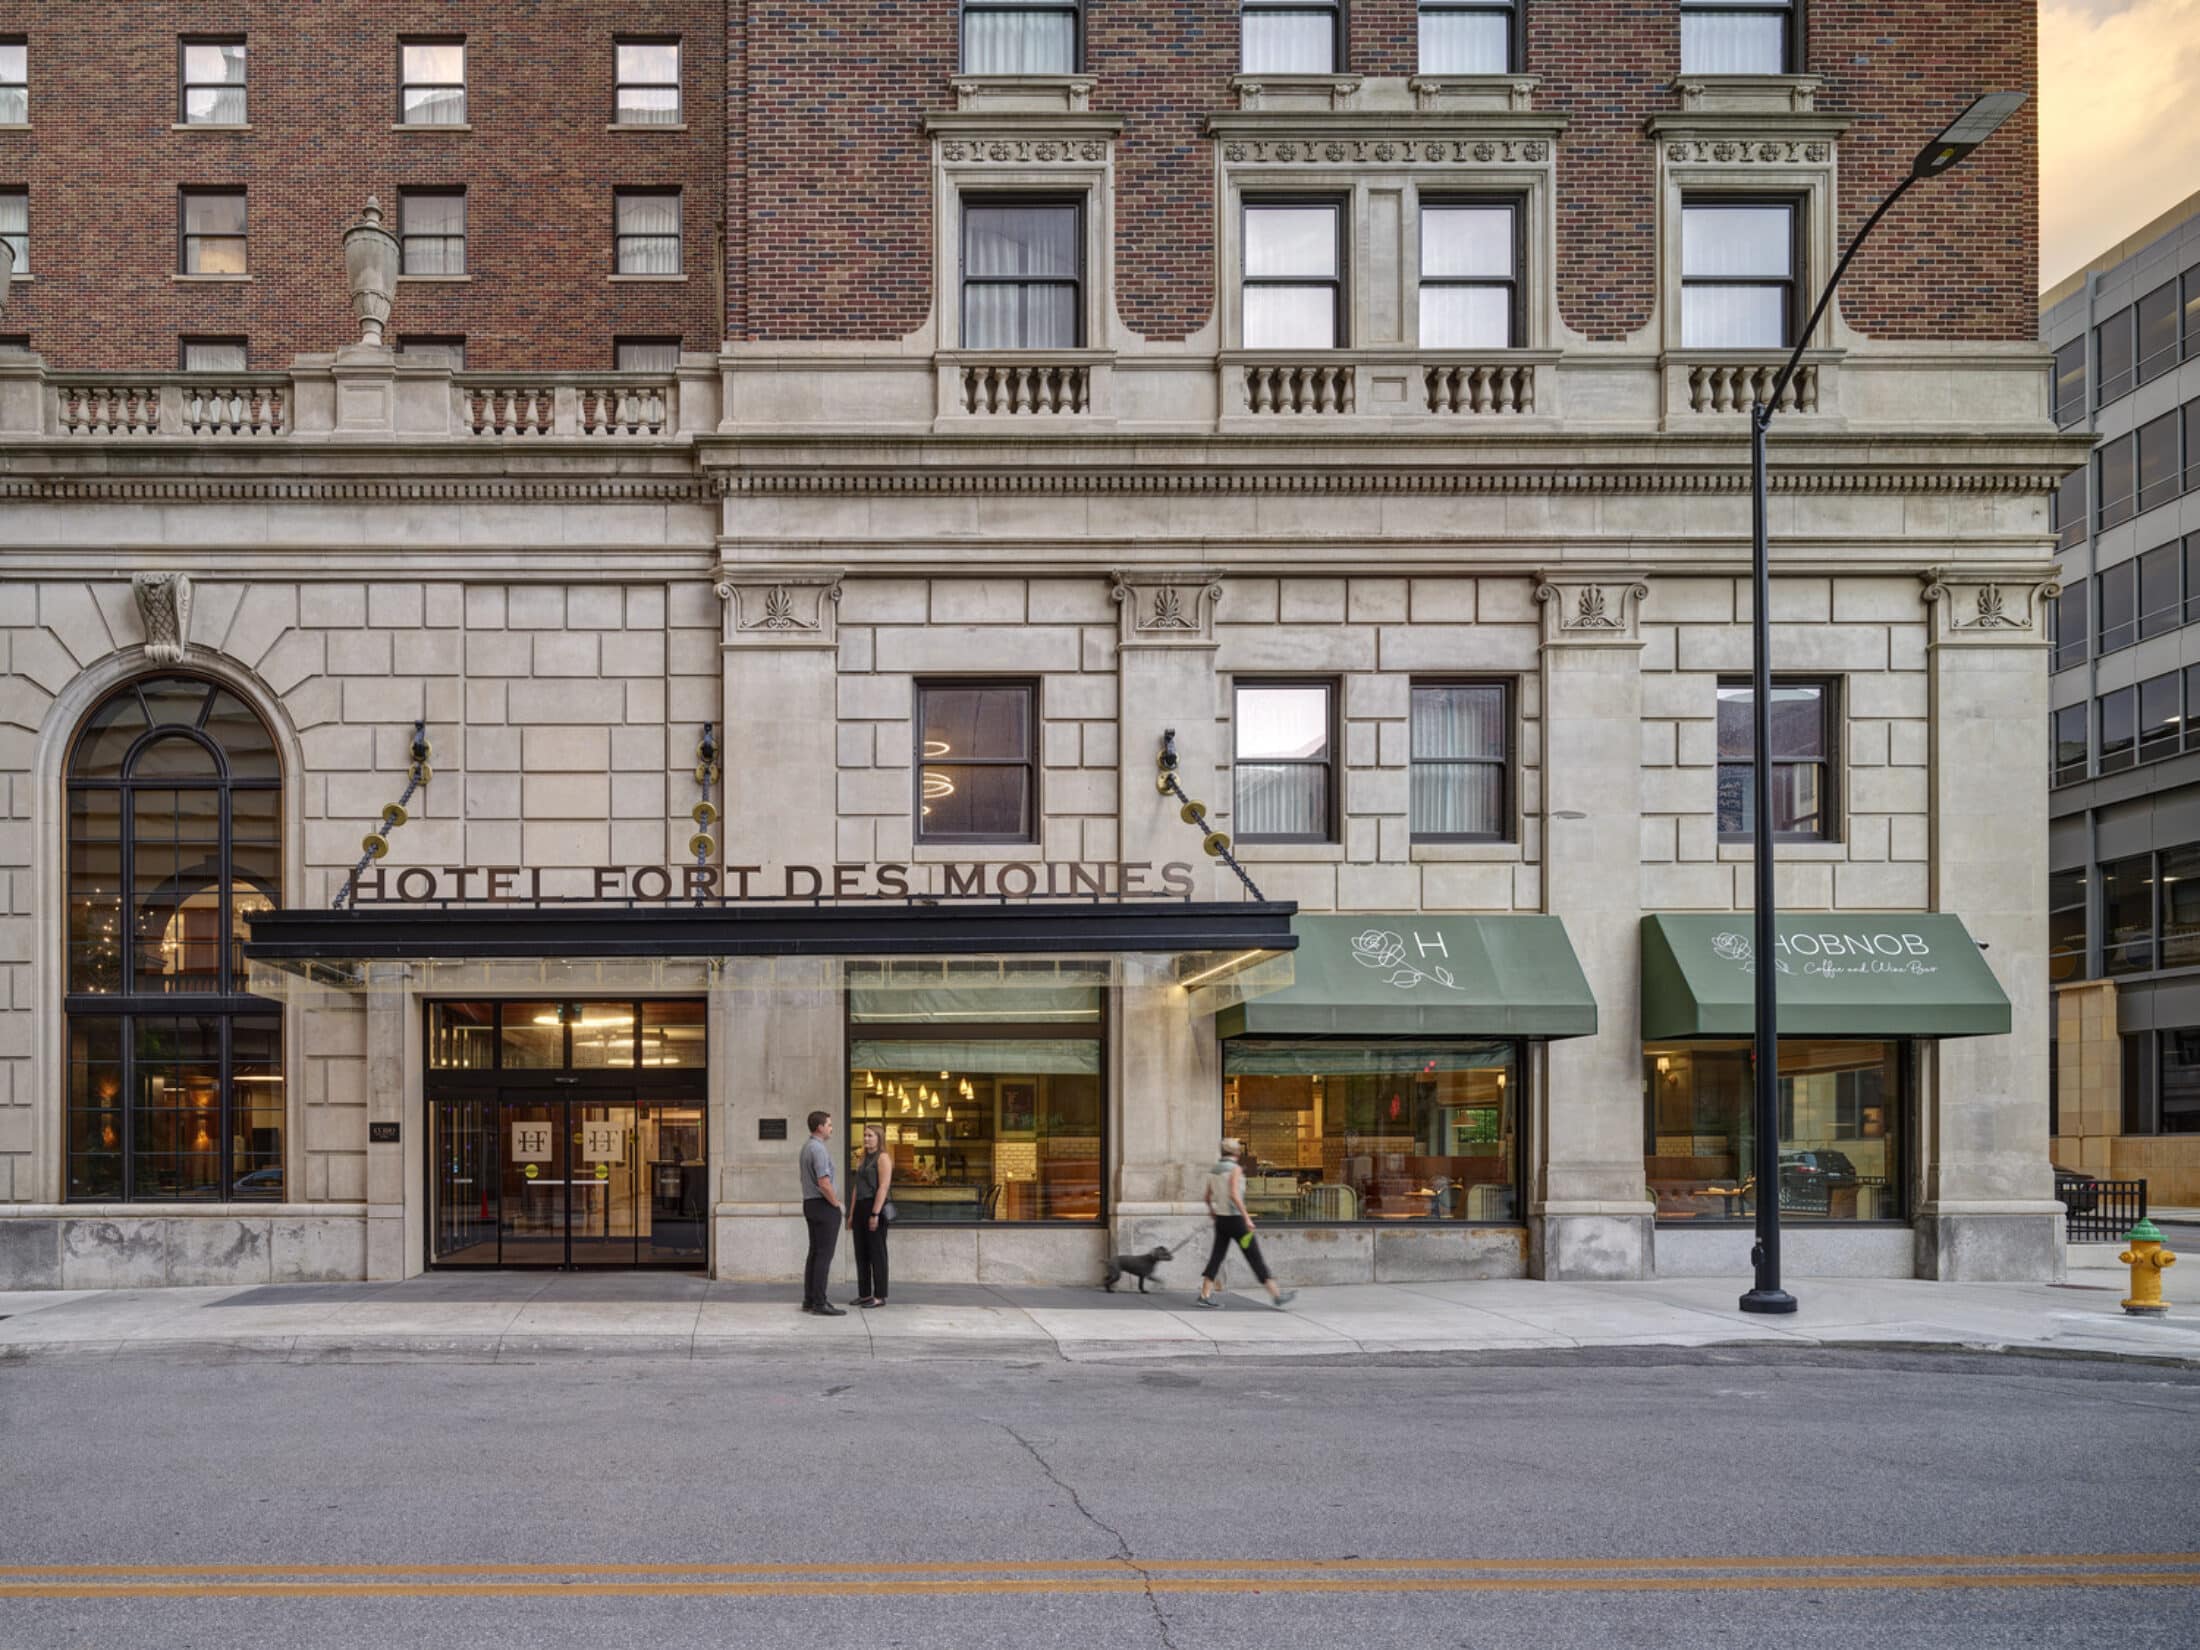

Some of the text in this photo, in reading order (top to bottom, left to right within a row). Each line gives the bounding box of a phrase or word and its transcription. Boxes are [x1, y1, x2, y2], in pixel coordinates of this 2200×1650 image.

[348, 862, 1195, 902] HOTEL FORT DES MOINES
[1413, 931, 1449, 958] H
